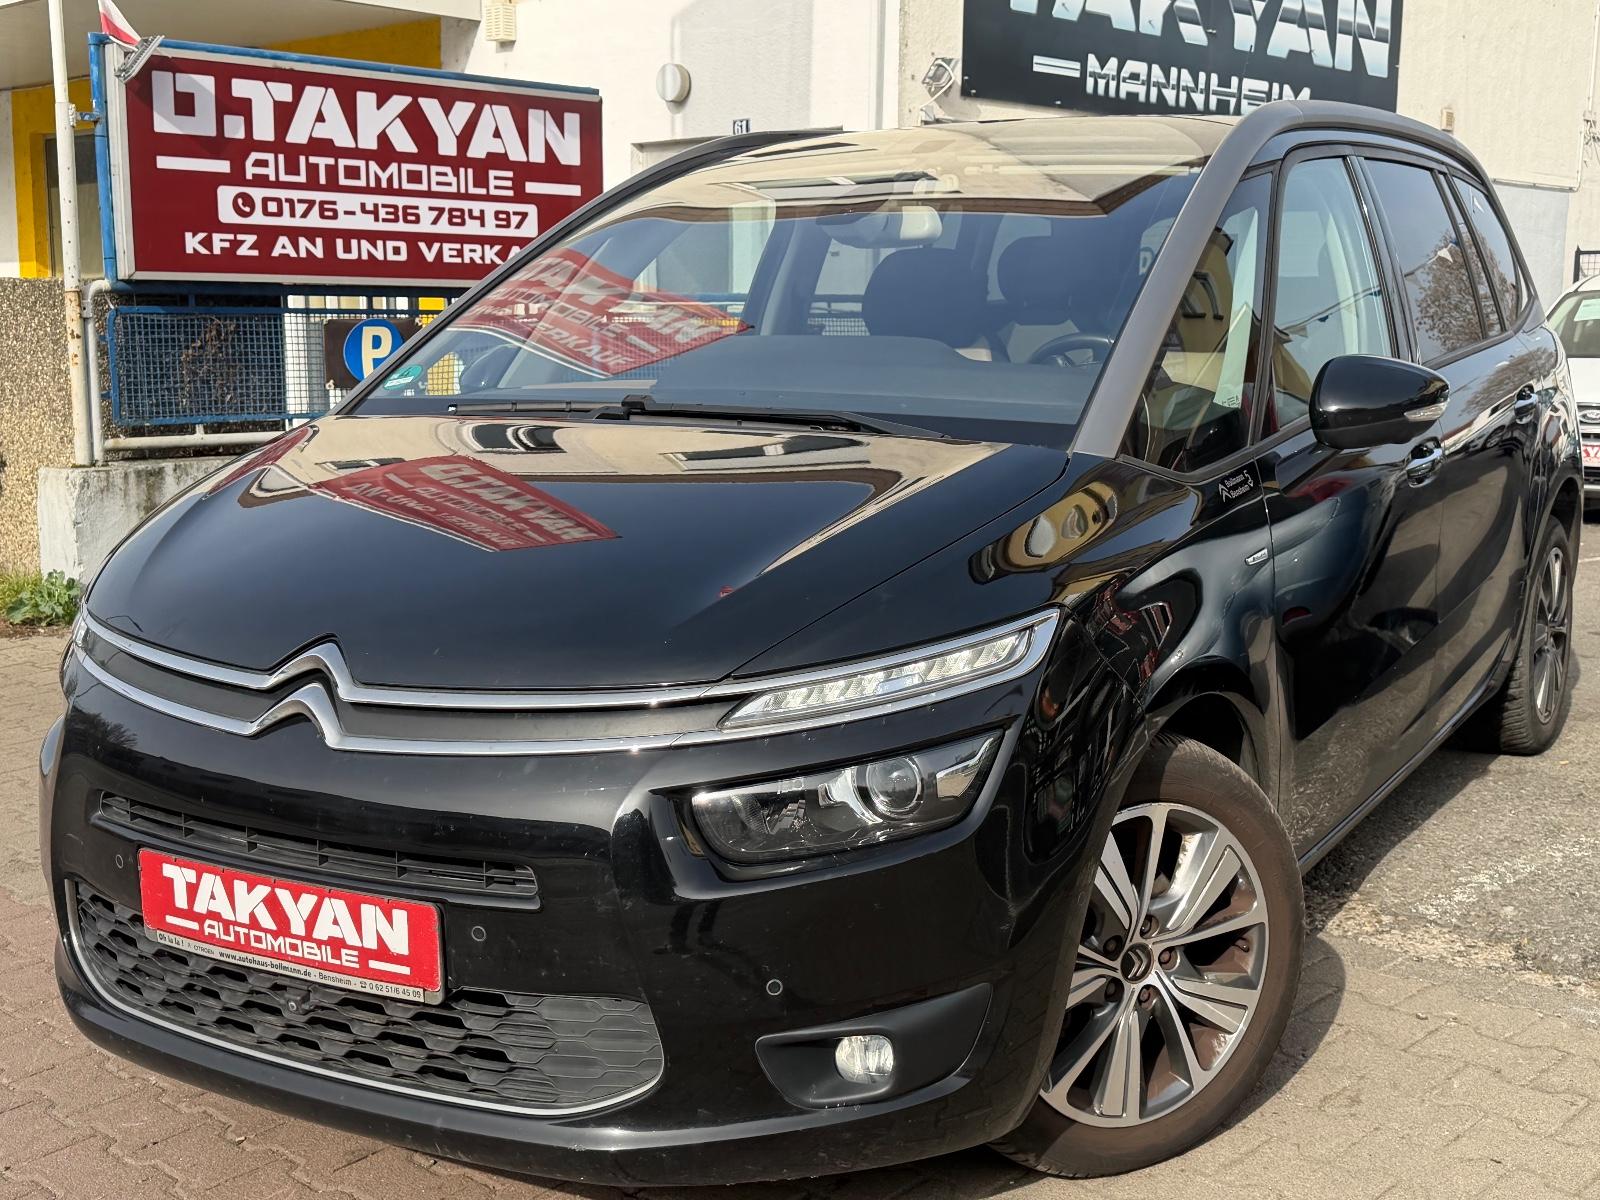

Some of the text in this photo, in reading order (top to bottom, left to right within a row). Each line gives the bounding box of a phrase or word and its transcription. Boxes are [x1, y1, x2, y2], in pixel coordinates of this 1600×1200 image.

[1009, 0, 1390, 78] YAN
[151, 70, 581, 166] O.TAKYAN
[244, 151, 515, 197] AUTOMOBILE
[428, 206, 486, 228] 784
[494, 210, 529, 229] 97
[184, 232, 260, 257] KFZ
[271, 235, 324, 259] AN
[336, 238, 408, 262] UND
[361, 326, 393, 379] P
[162, 862, 409, 956] TAKYAN
[203, 919, 360, 969] AUTOMOBILE
[218, 950, 312, 978] www.autohaus-bollmann.de
[318, 972, 352, 986] Bensheim
